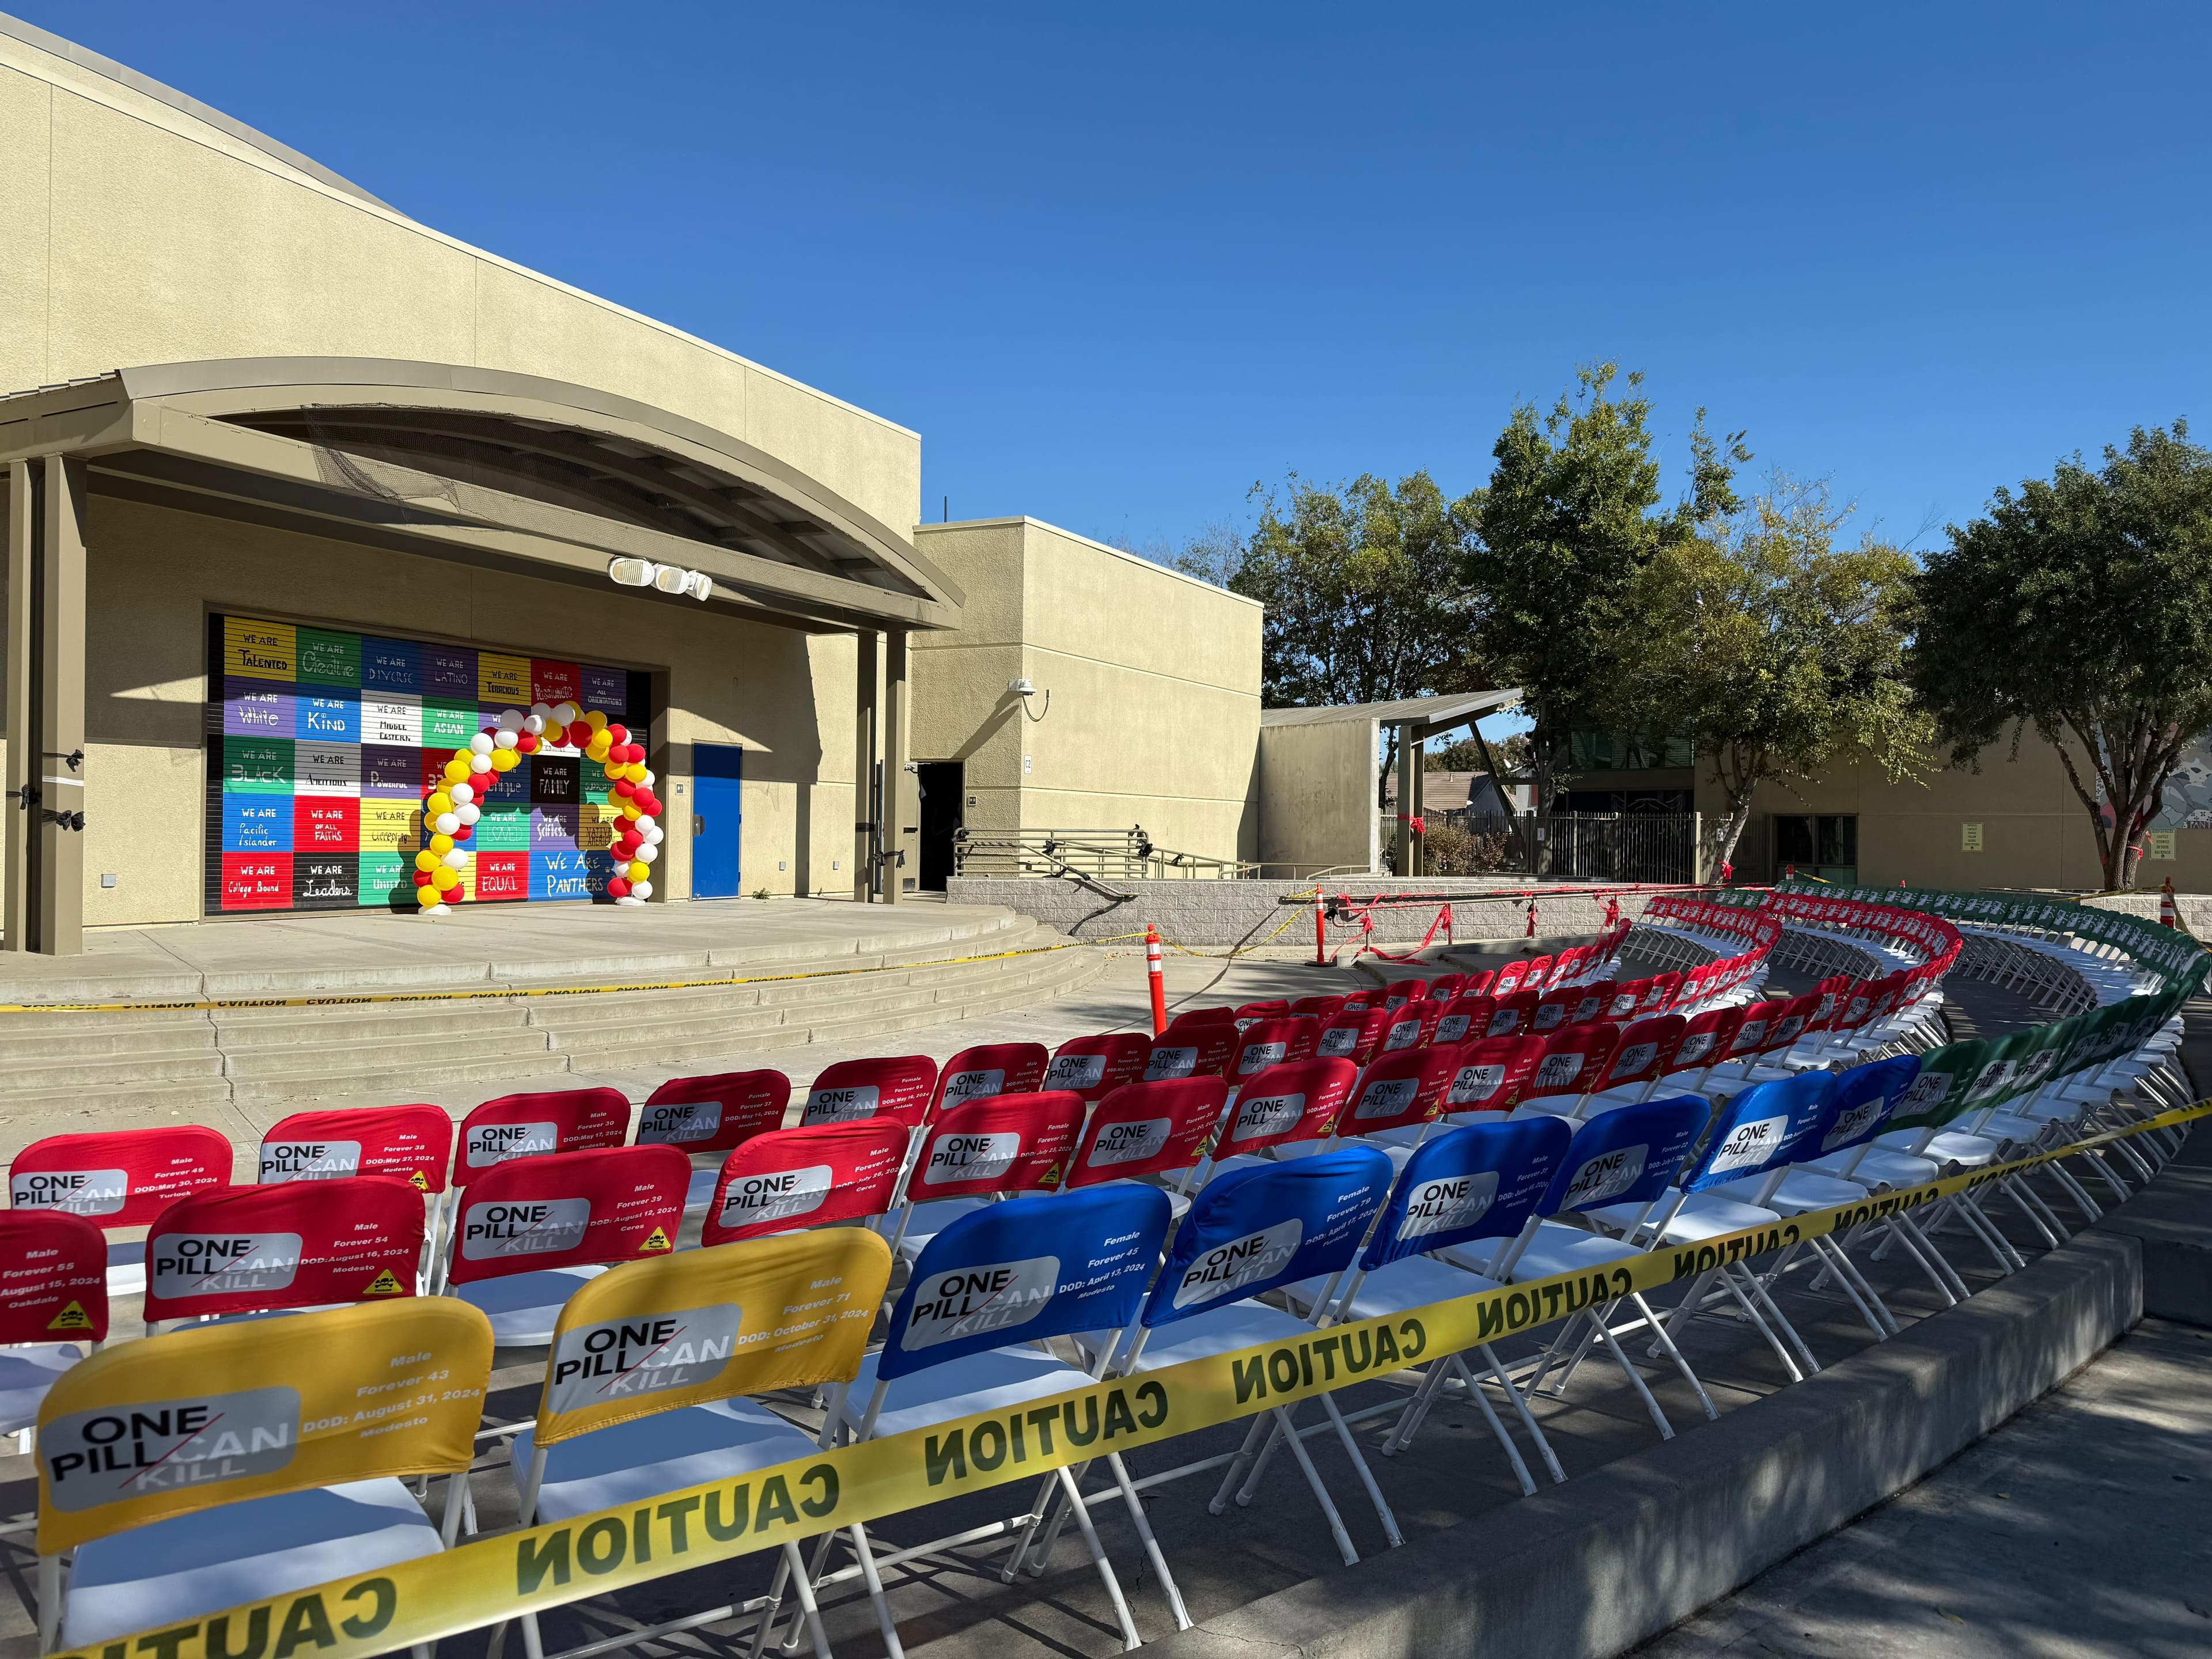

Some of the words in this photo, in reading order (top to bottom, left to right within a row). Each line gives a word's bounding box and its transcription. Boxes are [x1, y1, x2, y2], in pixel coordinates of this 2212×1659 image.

[244, 634, 256, 643] WE
[259, 637, 278, 646] ARE
[312, 642, 324, 652] WE
[327, 645, 344, 654] ARE
[302, 651, 354, 677] Creative
[376, 656, 388, 665] WE
[389, 658, 405, 667] ARE
[436, 658, 446, 666] WE
[449, 661, 463, 669] ARE
[369, 668, 414, 684] DIVERSE
[435, 669, 468, 684] LATINO
[492, 671, 502, 679] WE
[503, 672, 517, 680] ARE
[544, 672, 553, 680] WE
[592, 677, 601, 685] WE
[244, 692, 256, 701] WE
[259, 694, 278, 703] ARE
[312, 698, 325, 707] WE
[327, 700, 344, 709] ARE
[238, 706, 279, 726] White
[377, 705, 388, 713] WE
[391, 707, 406, 715] ARE
[436, 710, 446, 718] WE
[434, 722, 463, 734] ASIAN
[243, 750, 255, 759] WE
[258, 751, 276, 760] ARE
[313, 755, 325, 763] WE
[327, 756, 344, 764] ARE
[377, 757, 388, 766] WE
[391, 759, 406, 767] ARE
[231, 764, 286, 783] BLACK
[543, 767, 552, 775] WE
[540, 779, 569, 794] FAMILY
[242, 809, 255, 817] WE
[258, 809, 276, 817] ARE
[311, 810, 323, 819] WE
[325, 810, 343, 819] ARE
[376, 811, 387, 820] WE
[389, 812, 405, 820] ARE
[554, 815, 567, 823] ARE
[239, 823, 268, 835] Pacific
[315, 831, 342, 841] FAITHS
[238, 836, 276, 846] Islander
[375, 865, 387, 873] WE
[389, 865, 404, 873] ARE
[546, 853, 566, 870] WE
[574, 853, 600, 869] ARE
[241, 866, 254, 874] WE
[257, 866, 275, 874] ARE
[310, 866, 323, 874] WE
[325, 866, 342, 874] ARE
[229, 881, 251, 897] College
[257, 881, 279, 892] Bound
[302, 880, 353, 897] Leaders
[482, 876, 518, 891] EQUAL
[547, 875, 603, 897] PANTHERS
[1987, 1064, 2006, 1076] ONE
[1375, 1082, 1401, 1094] ONE
[1361, 1095, 1385, 1106] PILL
[482, 1127, 526, 1140] ONE
[1738, 1123, 1770, 1141] ONE
[469, 1141, 507, 1153] PILL
[948, 1138, 991, 1152] ONE
[1718, 1141, 1748, 1157] PILL
[930, 1153, 966, 1166] PILL
[29, 1175, 85, 1190] ONE
[15, 1190, 59, 1206] PILL
[486, 1206, 548, 1224] ONE
[467, 1224, 518, 1240] PILL
[1104, 1230, 1140, 1247] Female
[1088, 1252, 1125, 1268] Forever
[1126, 1247, 1139, 1256] 45
[810, 1277, 842, 1290] Male
[940, 1269, 1011, 1298] ONE
[1059, 1281, 1085, 1294] DOD:
[1086, 1272, 1109, 1287] April
[1111, 1268, 1122, 1278] 13,
[1123, 1263, 1145, 1273] 2024
[1077, 1284, 1115, 1300] Modesto
[783, 1297, 834, 1315] Forever
[836, 1293, 851, 1302] 71
[912, 1296, 975, 1327] PILL
[979, 1286, 1050, 1313] CAN
[738, 1331, 771, 1346] DOD:
[774, 1319, 821, 1338] October
[823, 1313, 839, 1324] 31,
[841, 1309, 869, 1319] 2024
[950, 1310, 1013, 1336] KILL
[584, 1319, 677, 1354] ONE
[774, 1334, 823, 1353] Modesto
[390, 1350, 432, 1368] Male
[555, 1351, 637, 1385] PILL
[640, 1335, 729, 1370] CAN
[356, 1374, 424, 1397] Forever
[427, 1369, 450, 1382] 43
[608, 1367, 690, 1395] KILL
[303, 1416, 349, 1434] DOD:
[353, 1400, 413, 1423] August
[416, 1394, 438, 1407] 31,
[441, 1388, 480, 1400] 2024
[82, 1406, 208, 1445] ONE
[359, 1416, 428, 1438] Modesto
[51, 1438, 157, 1482] PILL
[157, 1423, 288, 1463] CAN
[136, 1459, 246, 1491] KILL
